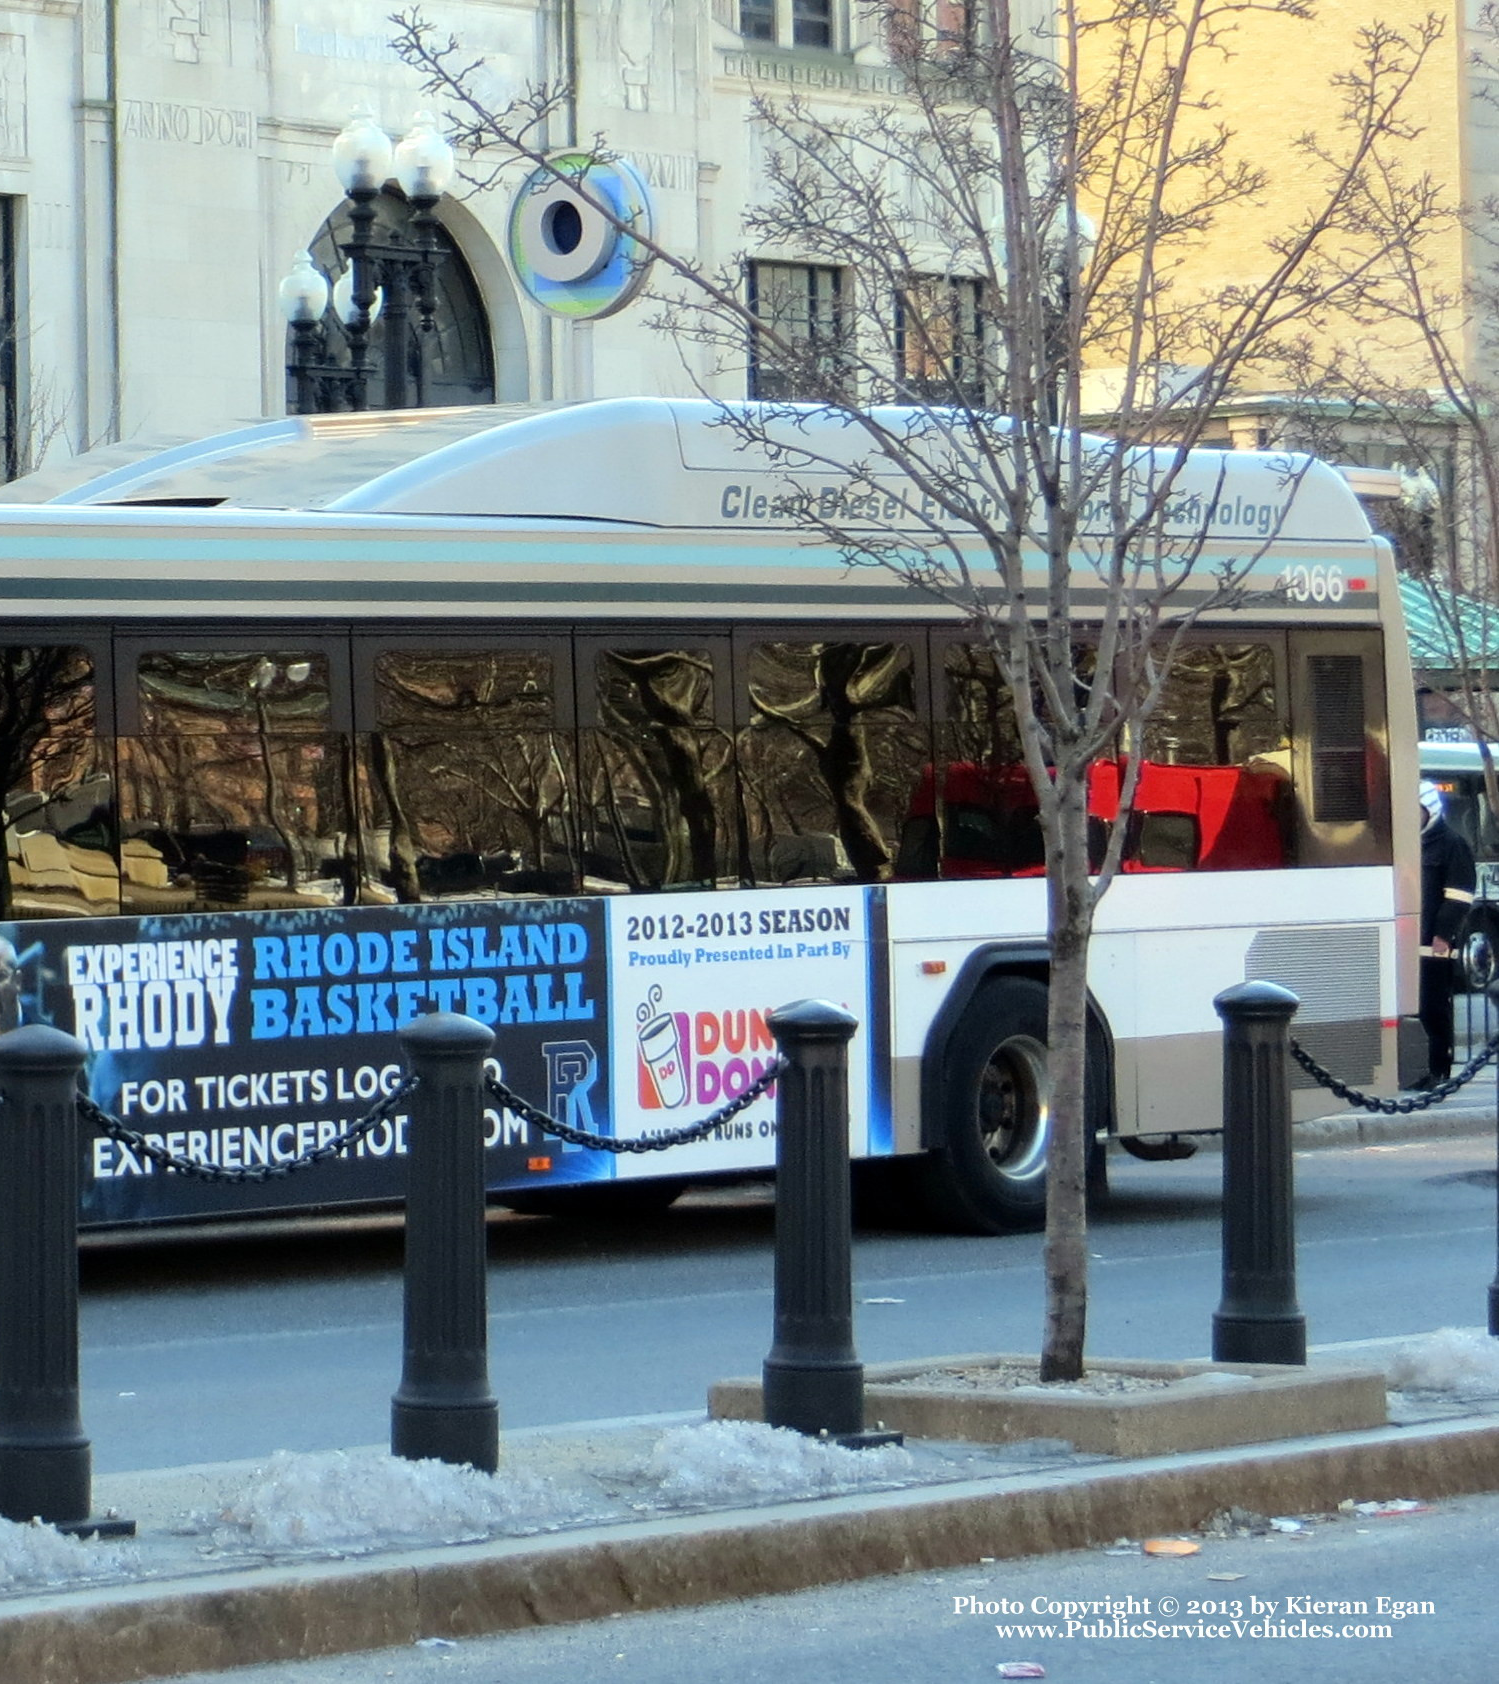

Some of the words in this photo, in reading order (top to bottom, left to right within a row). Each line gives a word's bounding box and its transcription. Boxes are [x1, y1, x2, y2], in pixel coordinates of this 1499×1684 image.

[818, 486, 907, 520] Diesel
[1281, 564, 1345, 602] 1066
[627, 911, 752, 941] 2012-2013
[758, 907, 851, 935] SEASON
[67, 938, 239, 985] EXPERIENCE
[252, 929, 419, 981] RHODE
[428, 922, 589, 972] ISLAND
[628, 948, 691, 968] Proudly
[695, 945, 774, 963] Presented
[777, 943, 794, 958] In
[796, 942, 829, 958] Part
[831, 941, 851, 960] By
[72, 977, 236, 1050] RHODY
[250, 971, 596, 1041] BASKETBALL
[121, 1079, 188, 1115] FOR
[195, 1068, 329, 1110] TICKETS
[336, 1064, 401, 1100] LOG
[714, 1121, 754, 1142] RUNS
